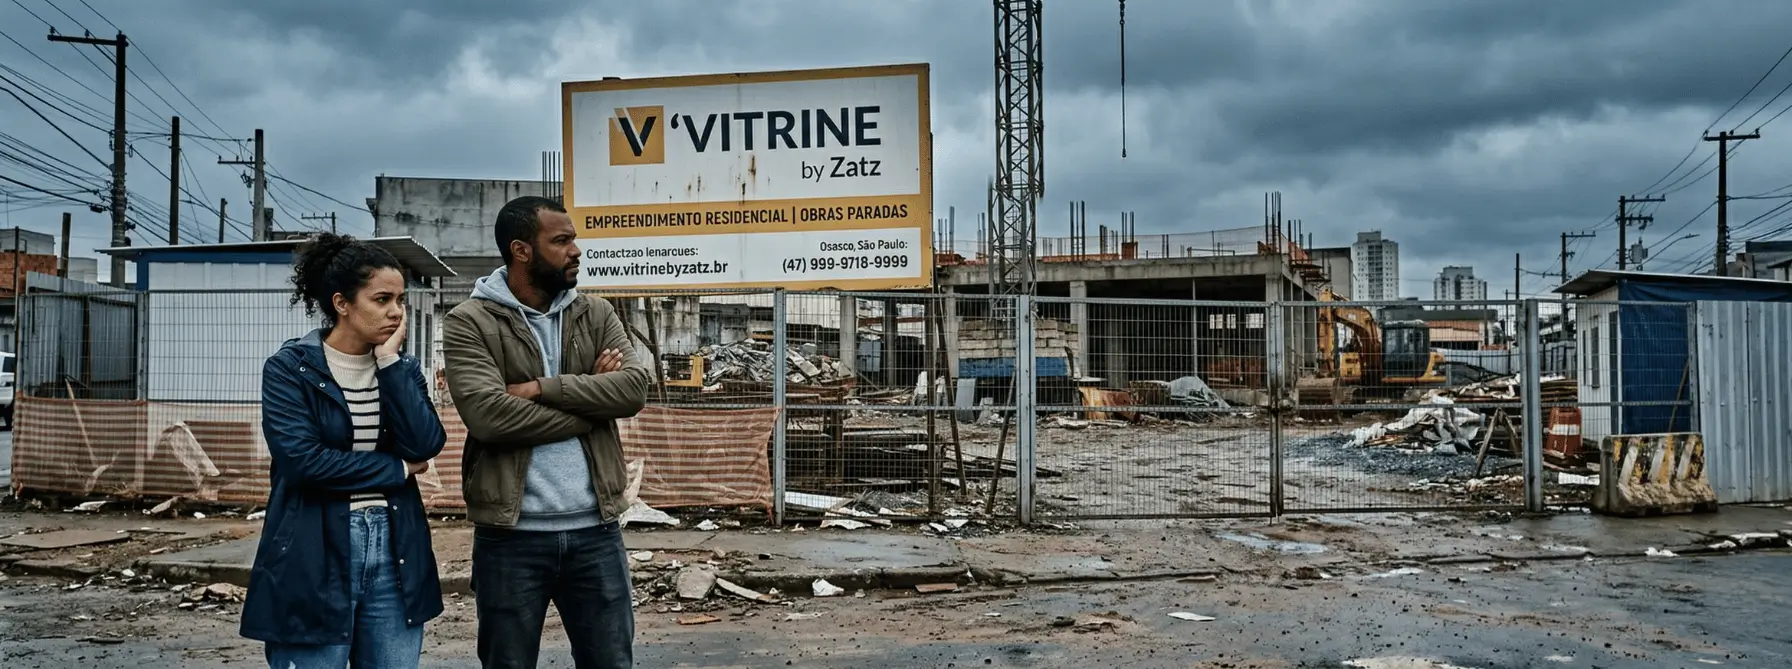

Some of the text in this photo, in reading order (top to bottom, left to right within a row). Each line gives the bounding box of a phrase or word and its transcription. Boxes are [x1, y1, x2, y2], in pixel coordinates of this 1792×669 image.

[801, 156, 882, 183] by Zatz
[585, 212, 701, 230] EMPREENDIMENTO
[705, 208, 789, 225] RESIDENCIAL
[800, 207, 844, 222] OBRAS
[847, 204, 908, 220] PARADAS
[820, 238, 908, 252] Osasco, São Paulo:
[587, 260, 729, 278] www.vitrinebyzatz.br
[782, 254, 908, 274] (47) 999-9718-9999
